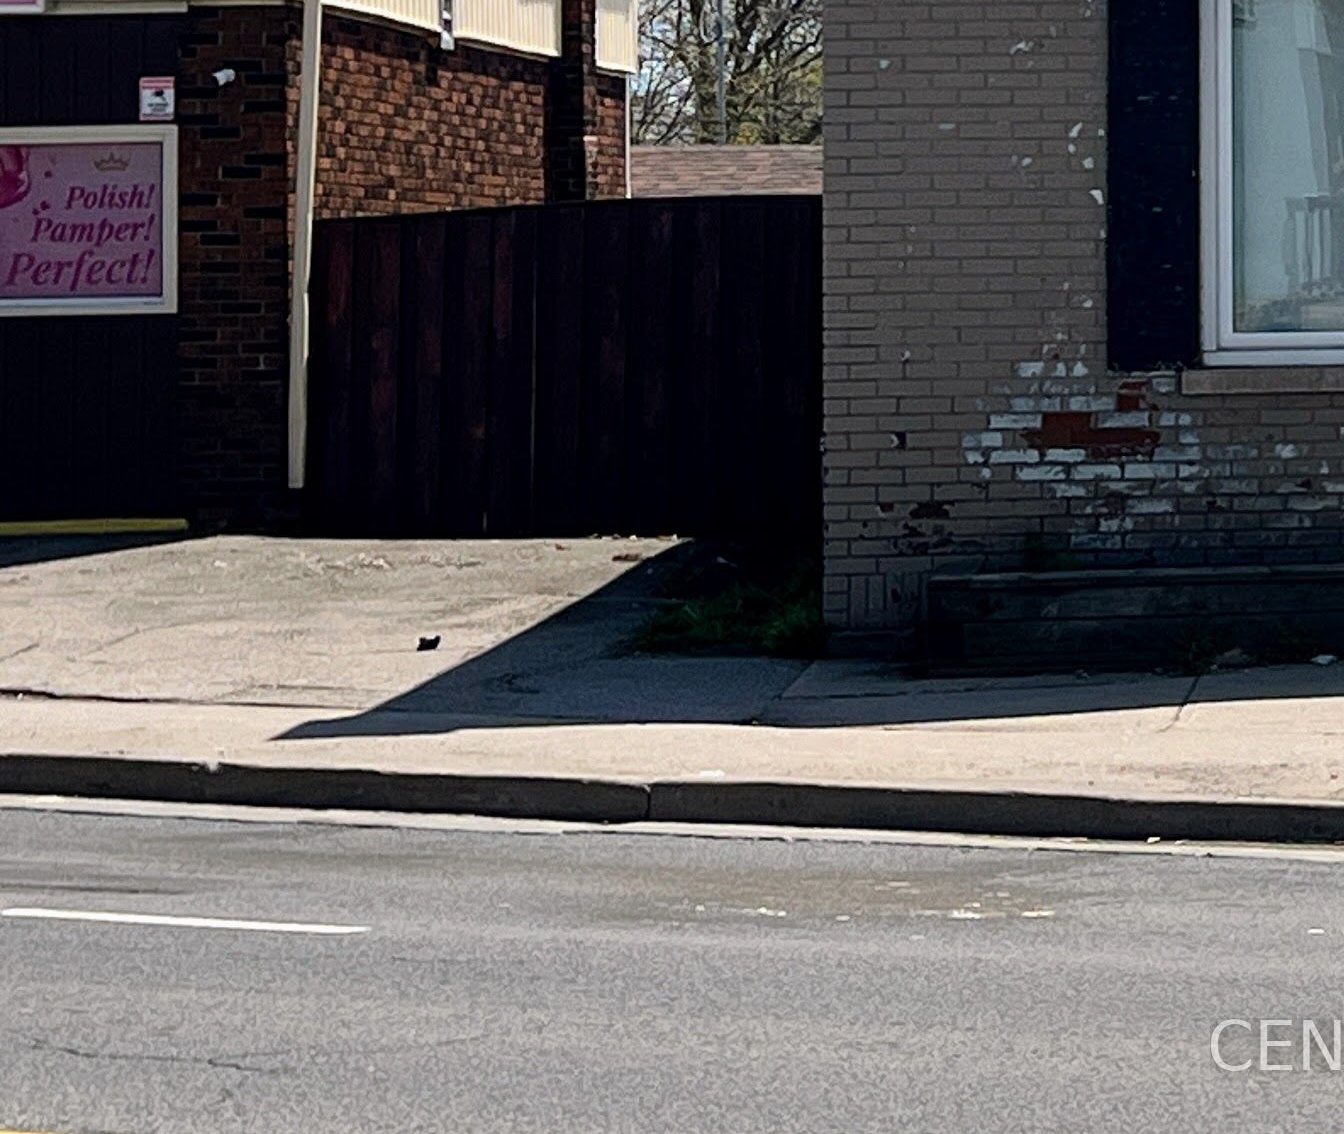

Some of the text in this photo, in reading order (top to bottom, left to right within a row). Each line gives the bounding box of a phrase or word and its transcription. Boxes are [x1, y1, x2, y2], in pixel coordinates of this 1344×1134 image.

[65, 183, 155, 210] Polish!
[30, 213, 155, 247] Pamper!
[5, 248, 155, 292] Perfect!
